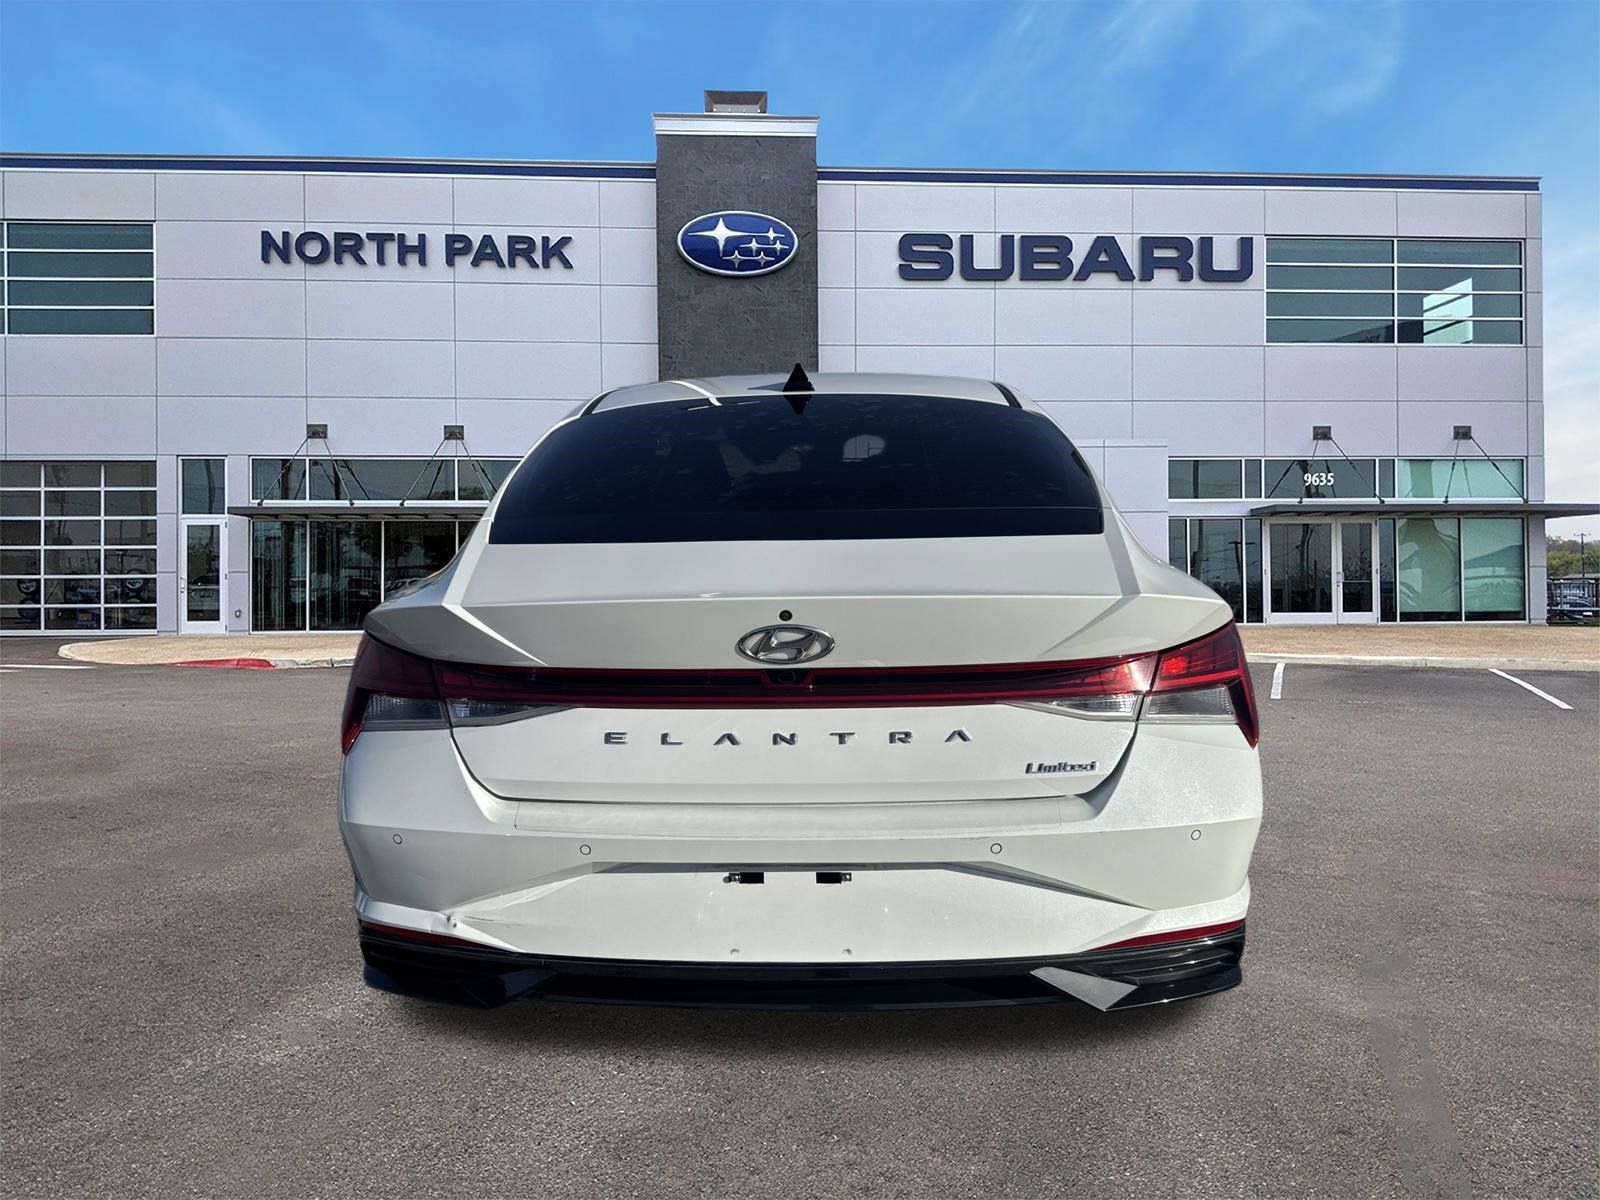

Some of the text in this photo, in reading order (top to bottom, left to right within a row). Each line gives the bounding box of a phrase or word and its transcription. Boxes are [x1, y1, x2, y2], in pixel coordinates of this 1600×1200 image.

[260, 231, 574, 269] NORTH PARK
[898, 233, 1255, 282] SUBARU
[1303, 472, 1335, 486] 9635
[603, 728, 972, 746] ELANTRA
